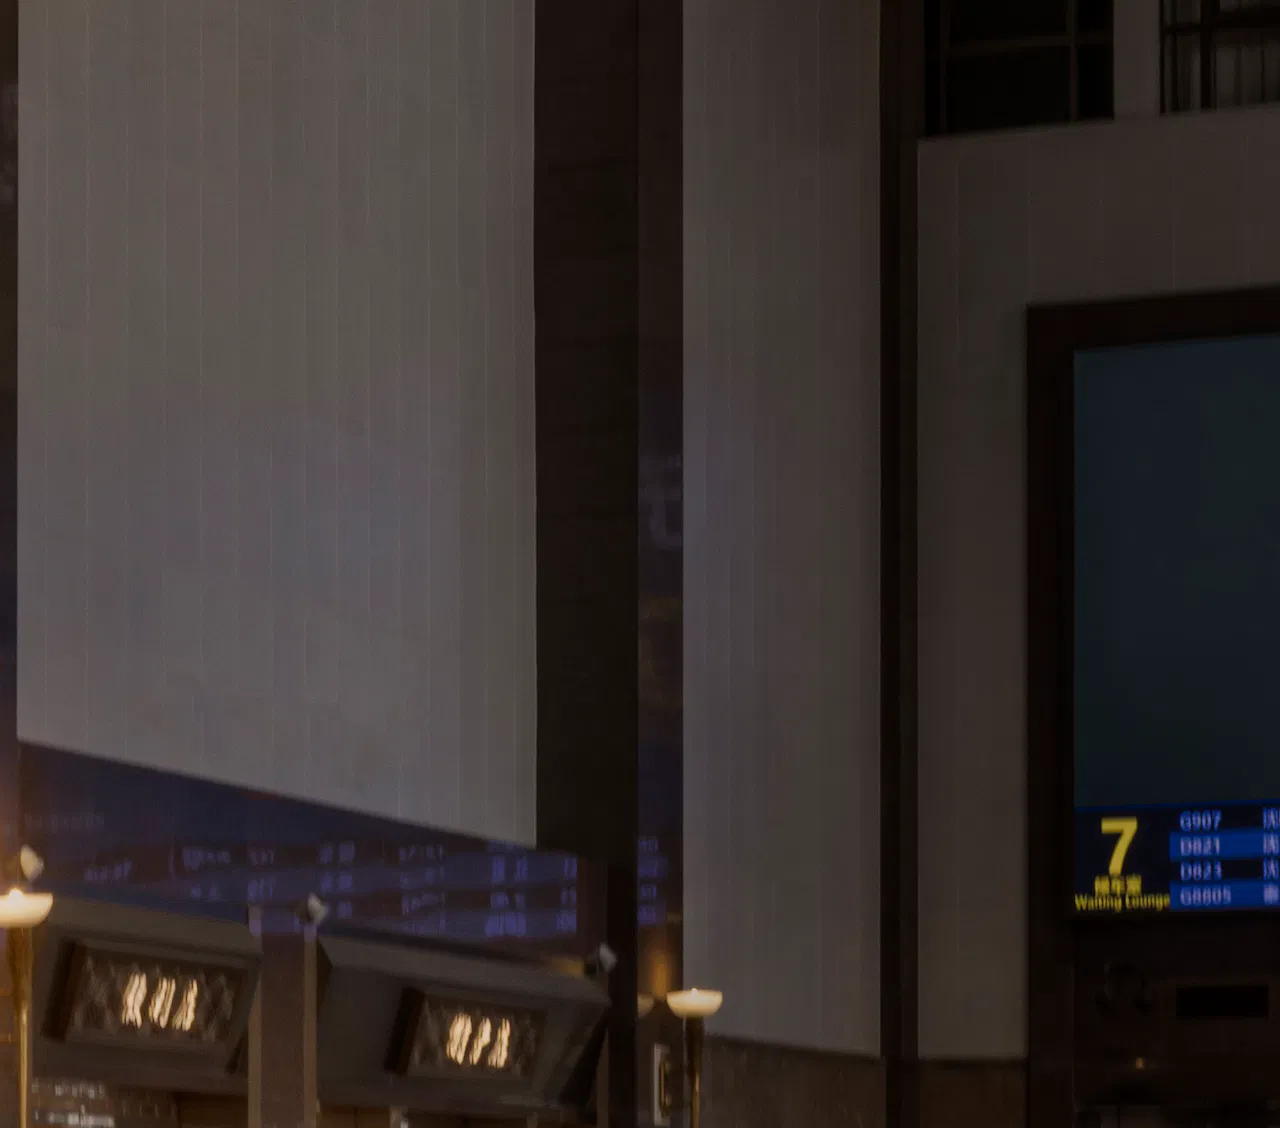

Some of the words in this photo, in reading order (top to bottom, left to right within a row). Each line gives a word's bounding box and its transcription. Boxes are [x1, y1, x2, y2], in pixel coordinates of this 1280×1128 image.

[1100, 816, 1138, 876] 7
[1074, 893, 1122, 912] Waiting
[1125, 892, 1170, 912] Lounge
